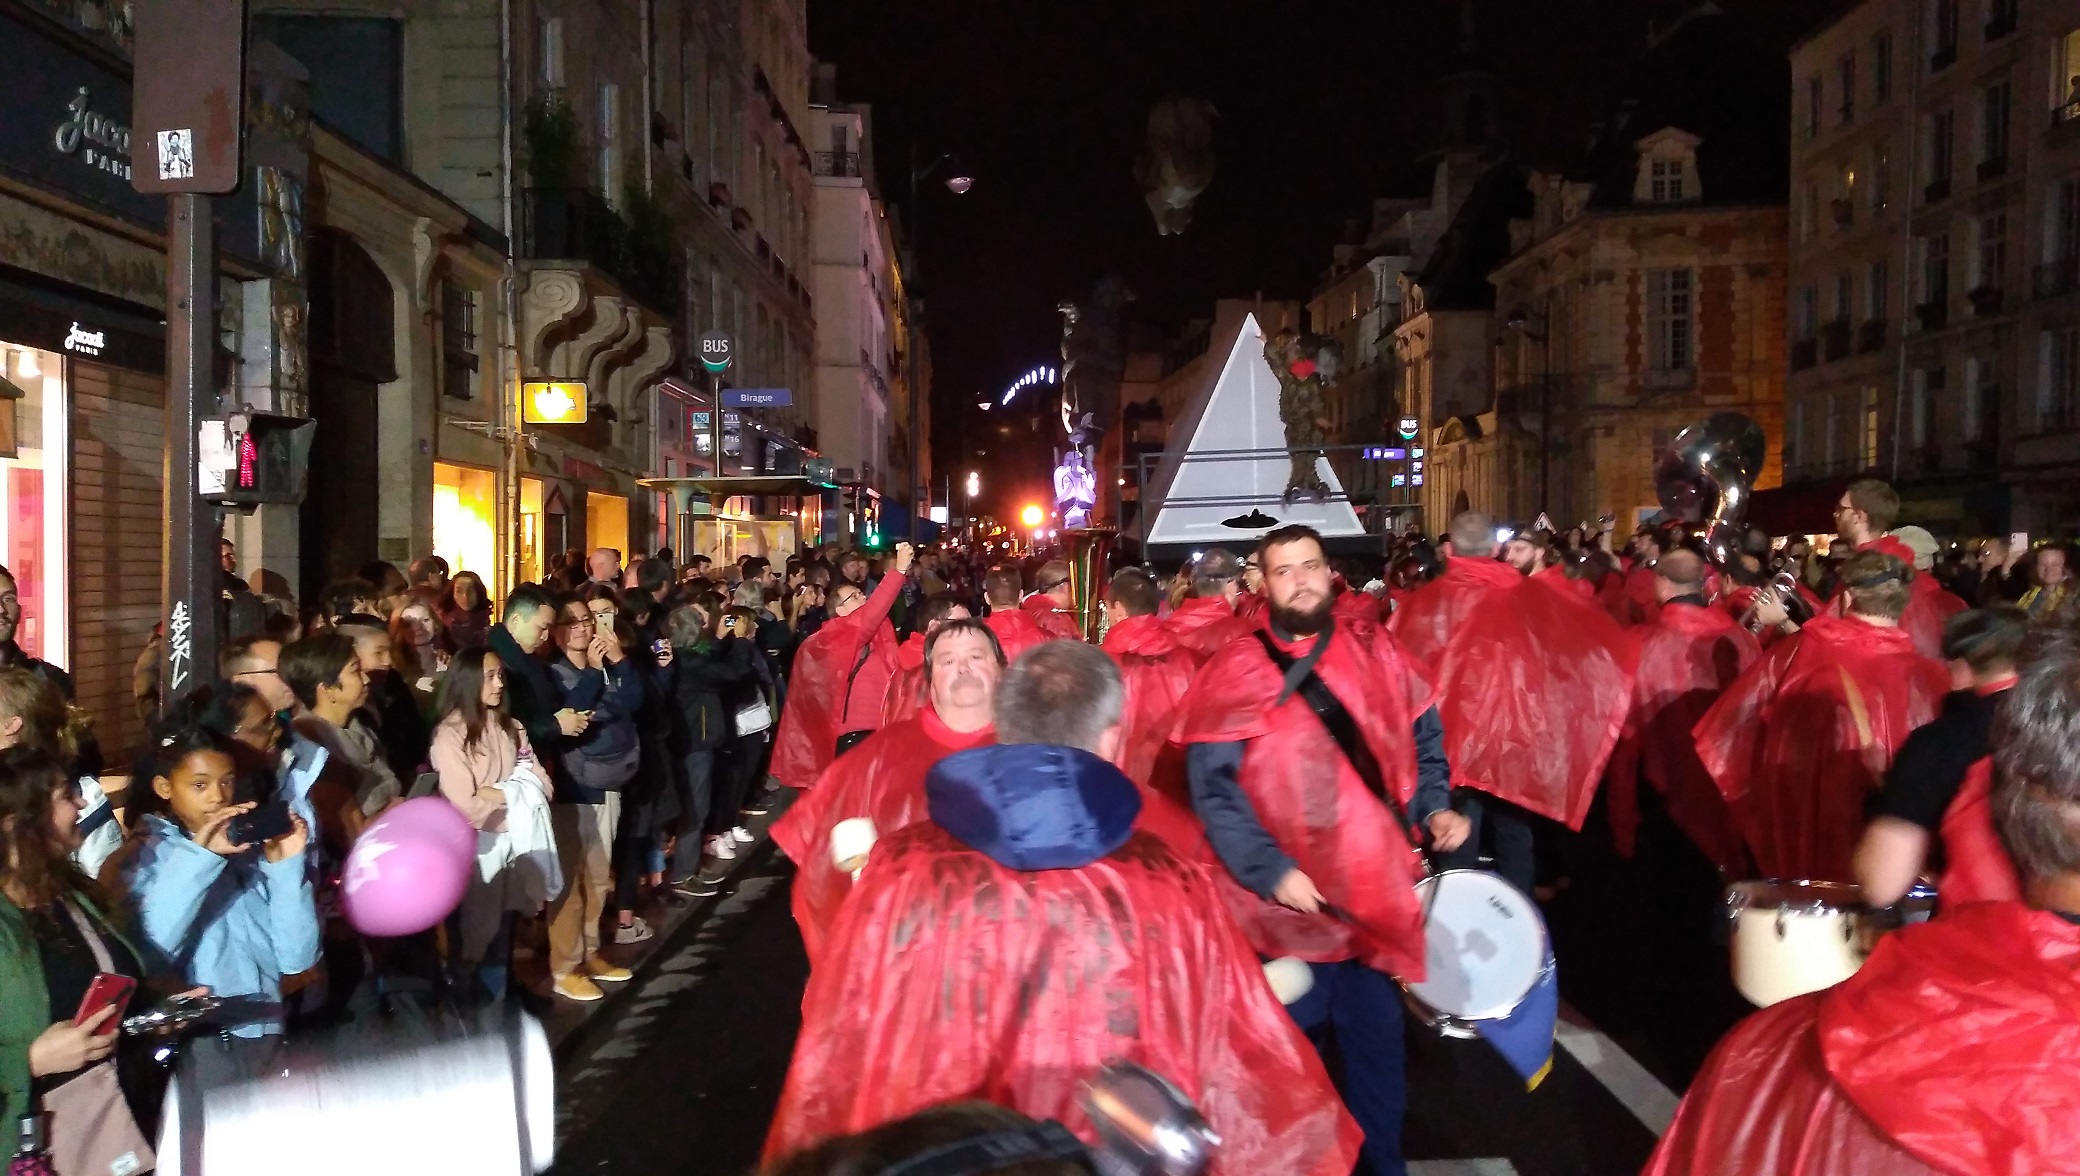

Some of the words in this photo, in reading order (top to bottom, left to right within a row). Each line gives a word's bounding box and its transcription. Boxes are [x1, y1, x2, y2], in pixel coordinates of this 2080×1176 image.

[86, 148, 132, 181] PARI
[75, 344, 99, 356] PARIS
[703, 339, 729, 353] BUS
[740, 393, 773, 403] Birague
[694, 413, 708, 422] 69
[1400, 419, 1417, 429] BUS
